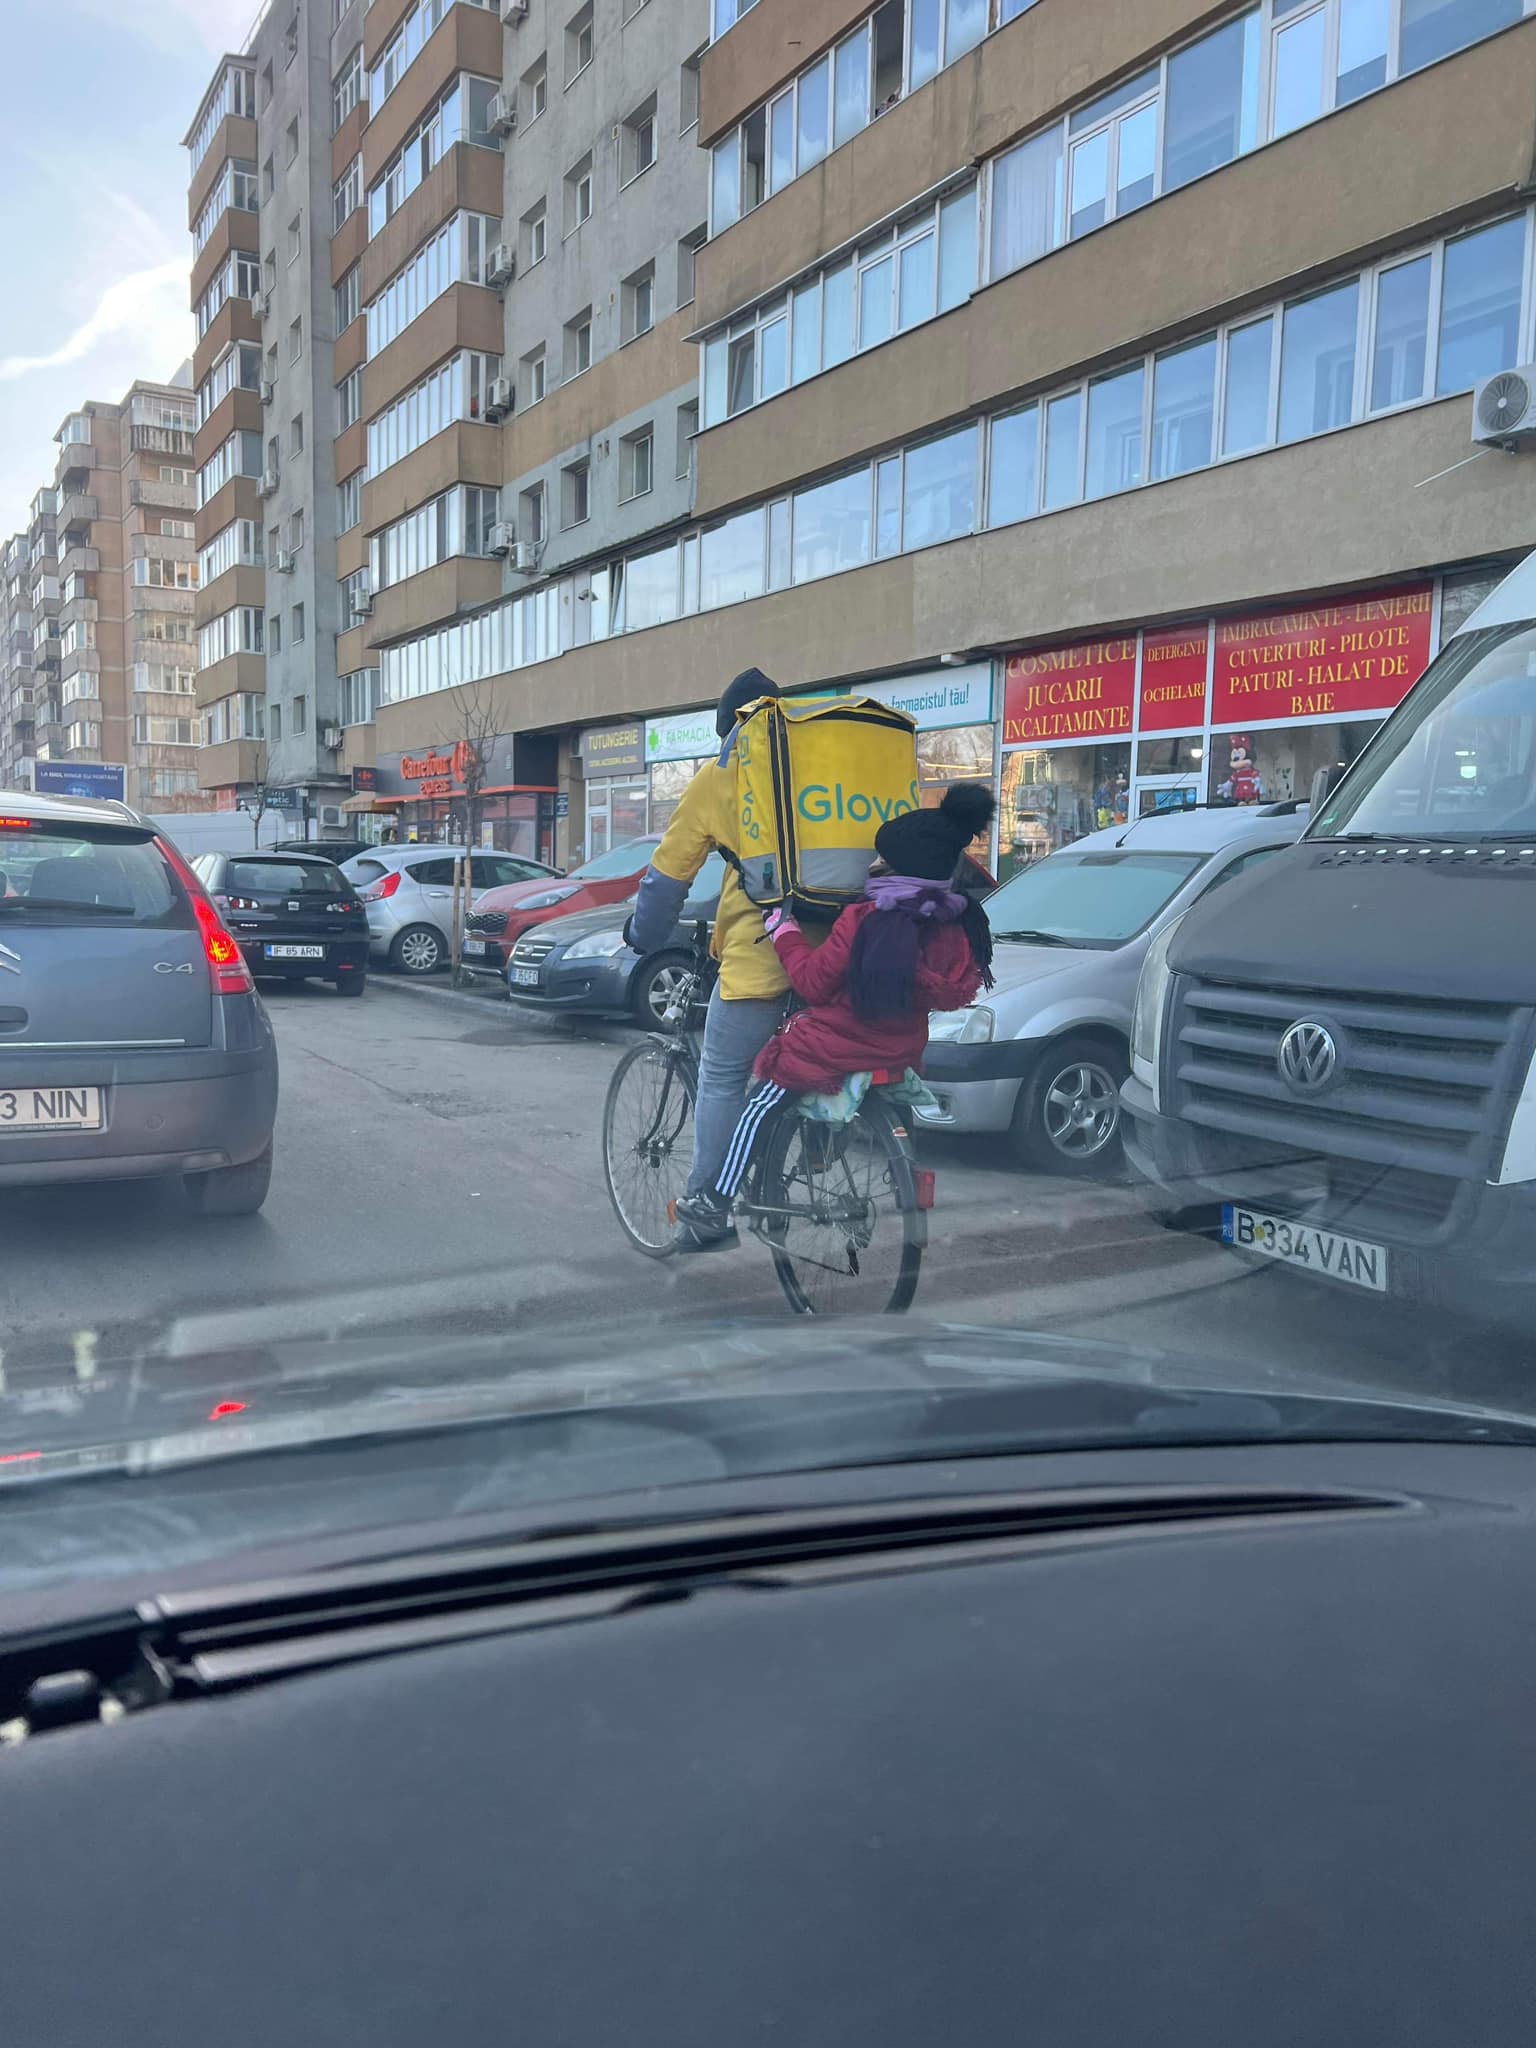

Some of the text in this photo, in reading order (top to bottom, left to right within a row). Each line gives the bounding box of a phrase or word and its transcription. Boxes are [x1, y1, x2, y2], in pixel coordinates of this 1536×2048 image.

[1223, 606, 1343, 643] IMBRACAMINTE
[1355, 592, 1431, 623] LENJERII
[1008, 638, 1136, 679] COSMETICE
[1148, 639, 1206, 663] DETERGENTI
[1229, 638, 1326, 669] CUVERTURI
[1340, 626, 1410, 654] PILOTE
[1229, 669, 1295, 695] PATURI
[1308, 659, 1376, 686] HALAT
[1380, 655, 1409, 678] DE
[1025, 677, 1104, 712] JUCARII
[1143, 682, 1207, 705] OCHELARI
[1291, 692, 1335, 715] BAIE
[665, 726, 711, 743] FARMACIA
[1005, 706, 1130, 740] INCALTAMINTE
[588, 729, 639, 751] TUTUNGERIE
[400, 751, 451, 779] Carrefour
[420, 779, 451, 796] express
[301, 946, 320, 957] ARN
[153, 961, 195, 975] C4
[33, 1090, 88, 1120] NIN
[1315, 1233, 1377, 1285] VAN
